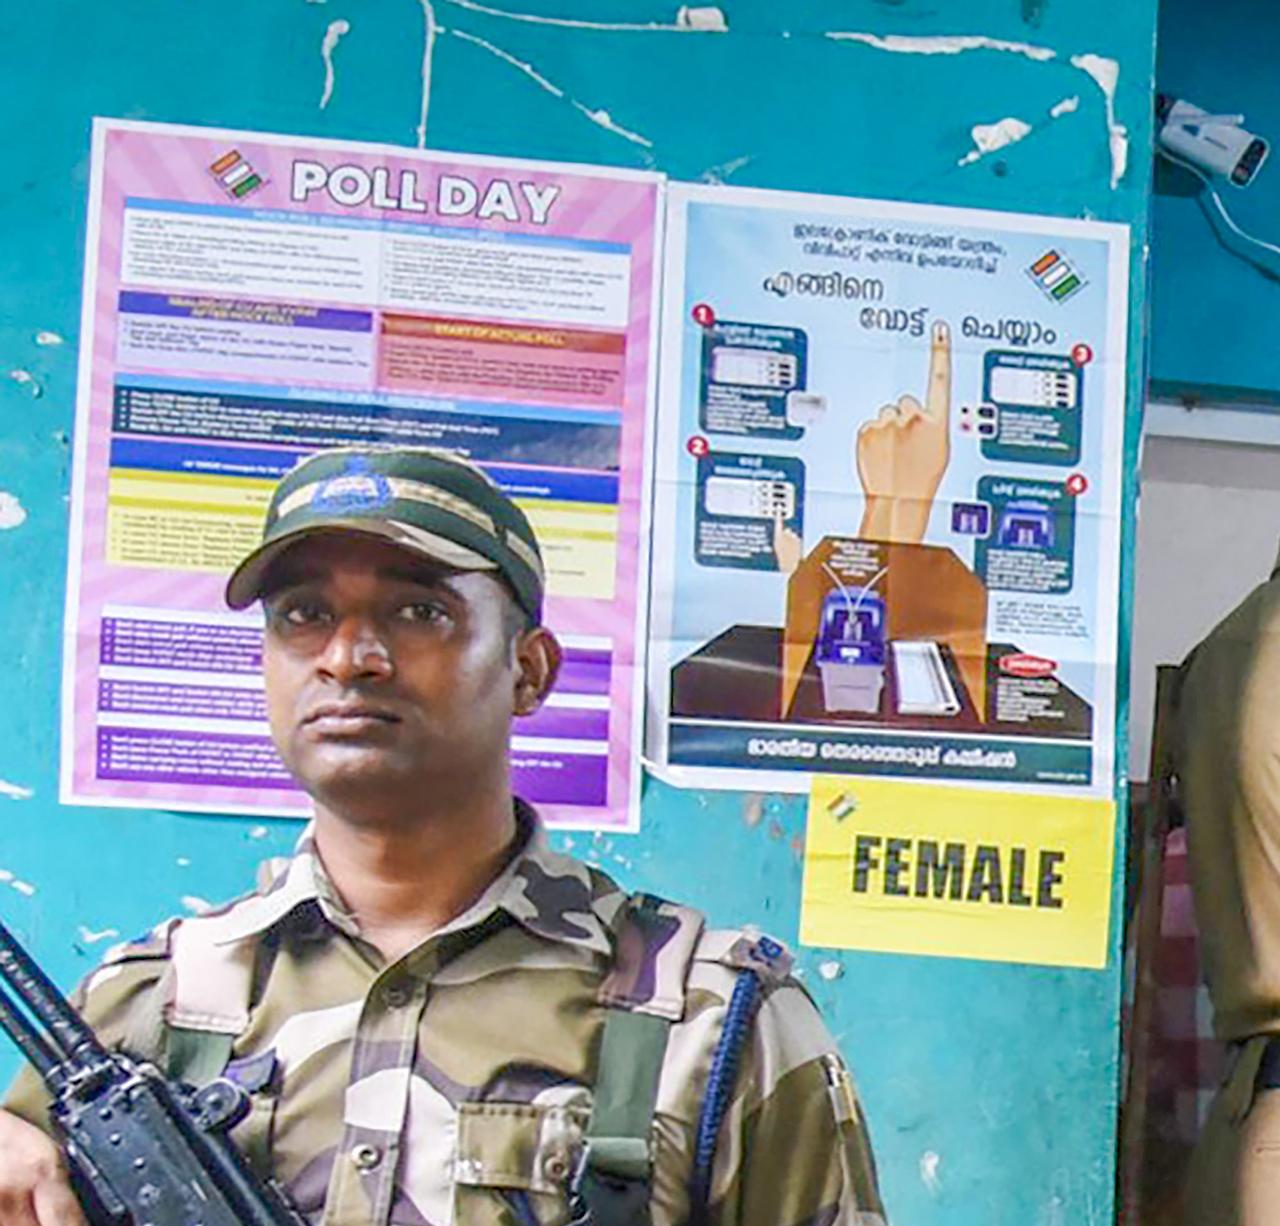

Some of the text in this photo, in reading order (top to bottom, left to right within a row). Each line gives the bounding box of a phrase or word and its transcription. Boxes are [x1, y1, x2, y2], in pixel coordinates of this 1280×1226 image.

[292, 160, 427, 213] POLL
[436, 174, 562, 226] DAY
[698, 307, 707, 322] 1
[860, 307, 1057, 345] വോട്ട് ചെയ്യാം
[693, 440, 704, 453] 2
[1073, 477, 1083, 492] 4
[852, 834, 1065, 909] FEMALE
